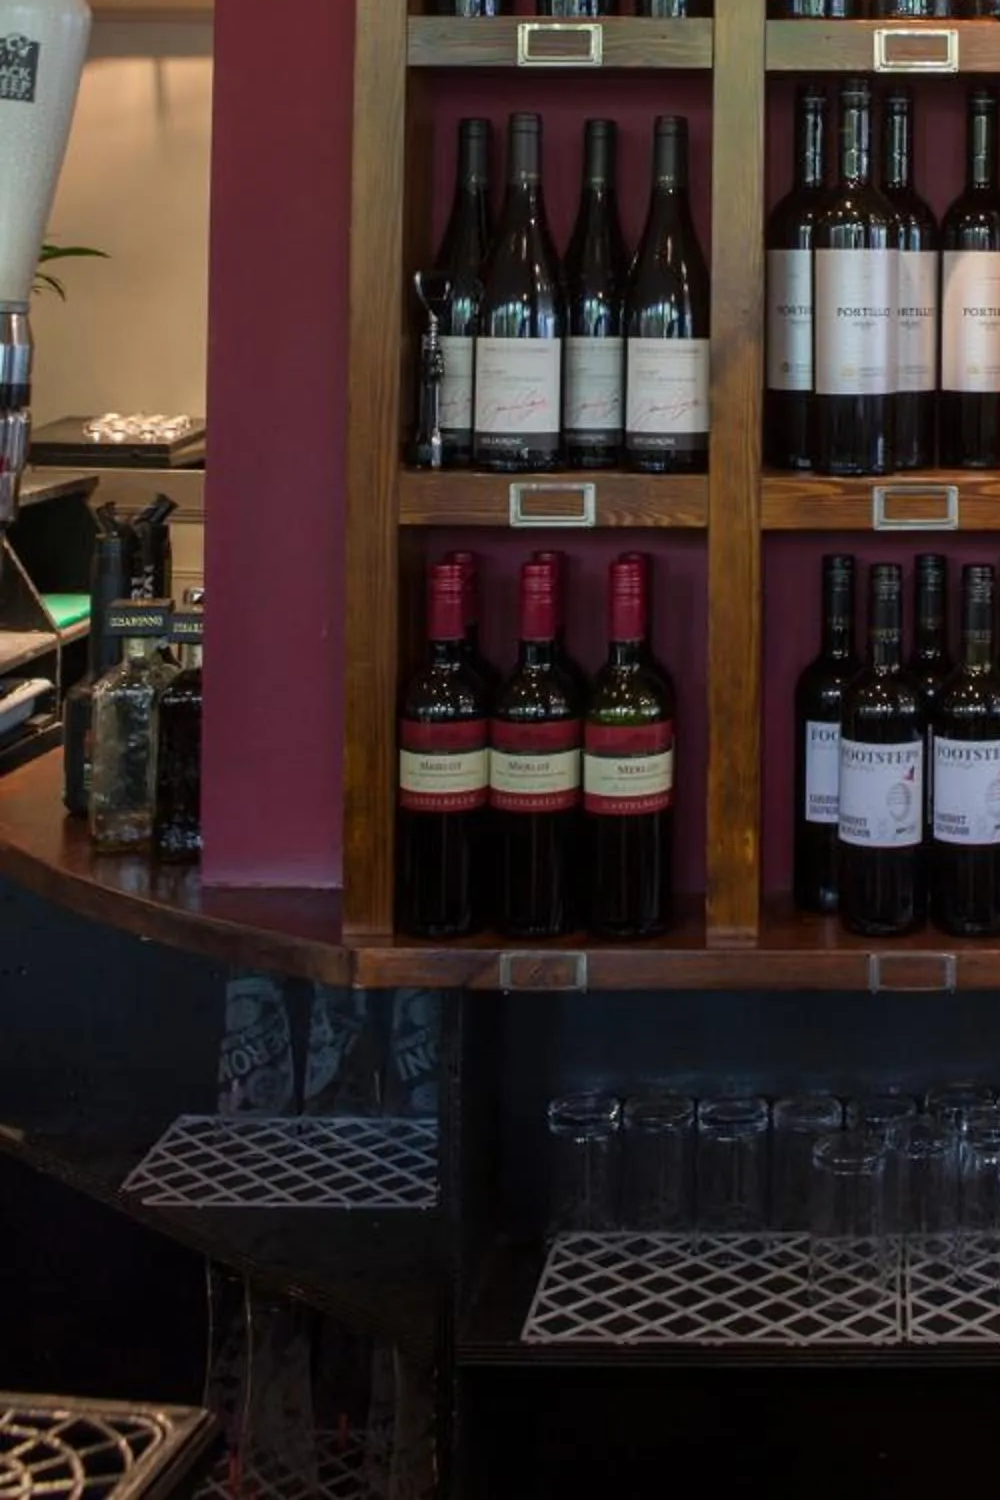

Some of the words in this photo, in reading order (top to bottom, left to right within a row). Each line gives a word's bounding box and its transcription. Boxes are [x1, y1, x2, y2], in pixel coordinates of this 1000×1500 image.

[0, 66, 32, 81] ACK
[0, 79, 32, 93] EEP
[777, 304, 812, 317] PORTI
[837, 306, 891, 317] PORTILLO
